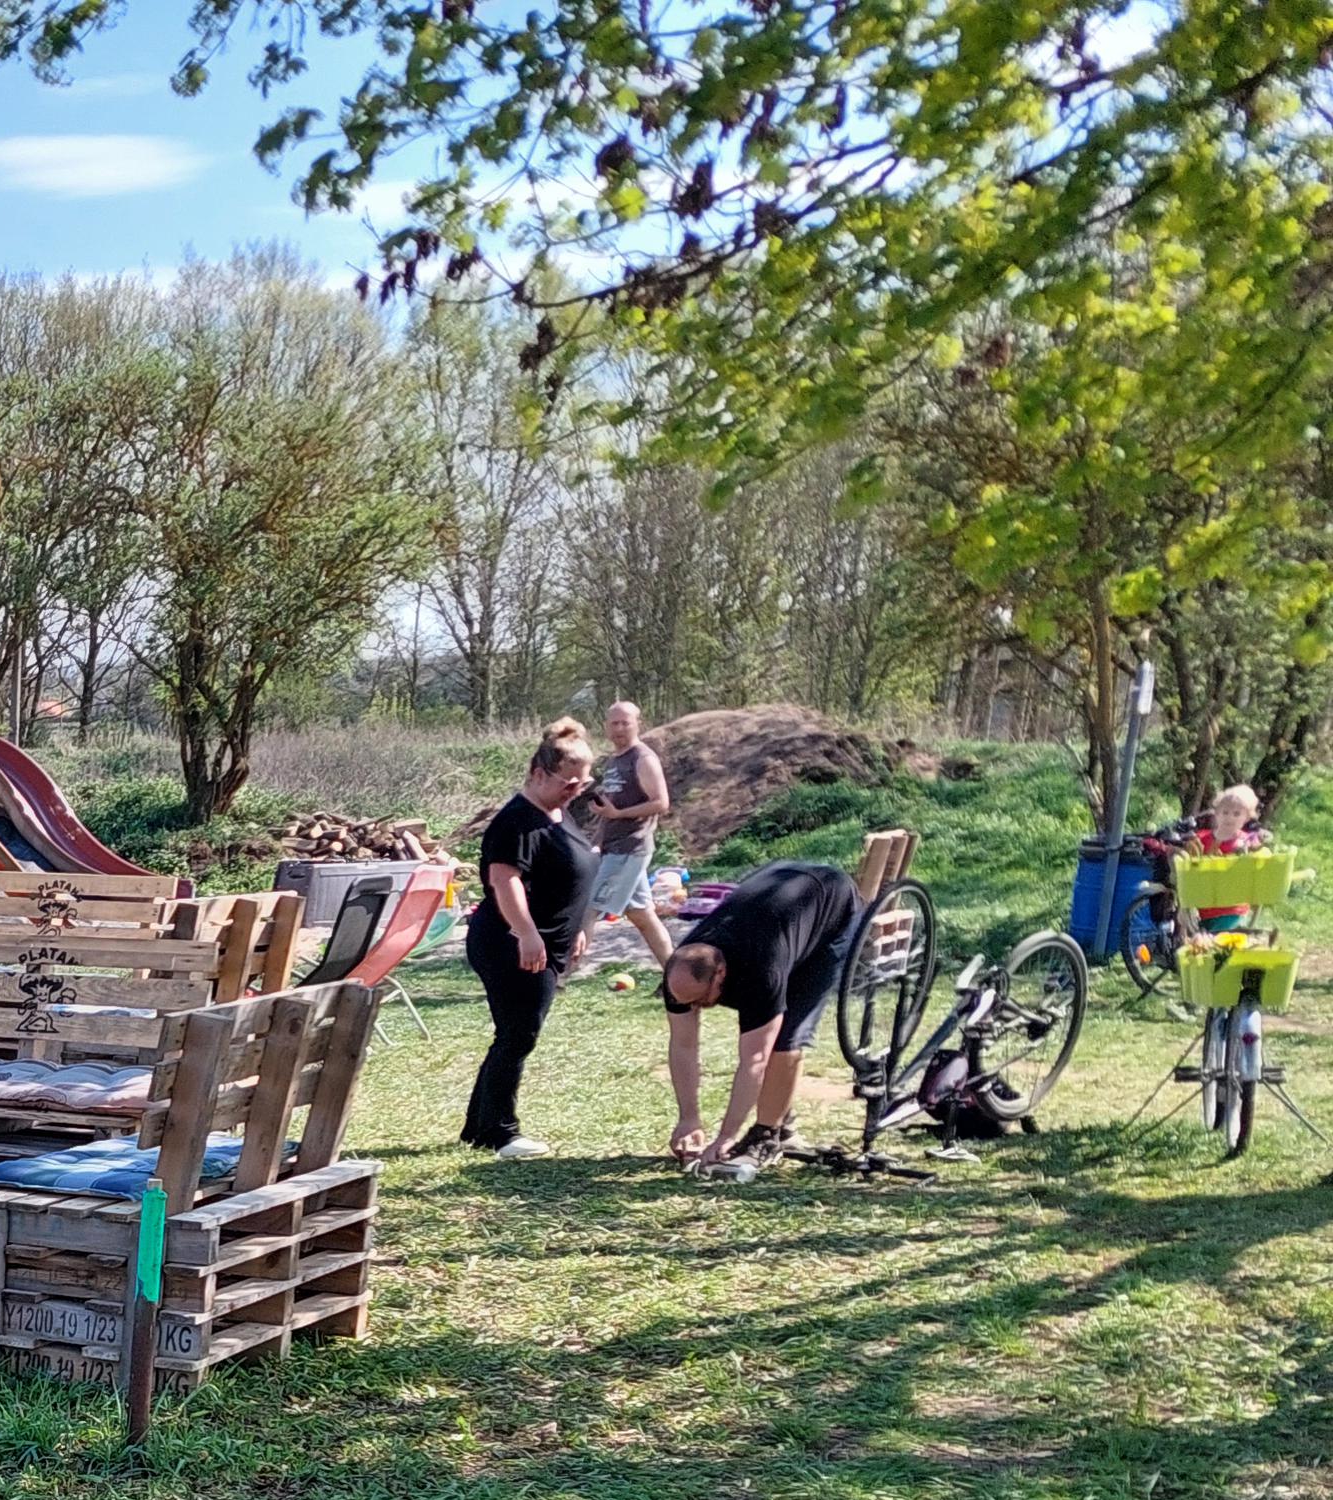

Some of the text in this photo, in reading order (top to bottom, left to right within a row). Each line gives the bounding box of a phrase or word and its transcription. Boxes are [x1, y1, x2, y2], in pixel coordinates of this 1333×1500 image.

[3, 1302, 54, 1334] Y1200
[59, 1310, 78, 1338] 19
[84, 1316, 118, 1344] 1/23
